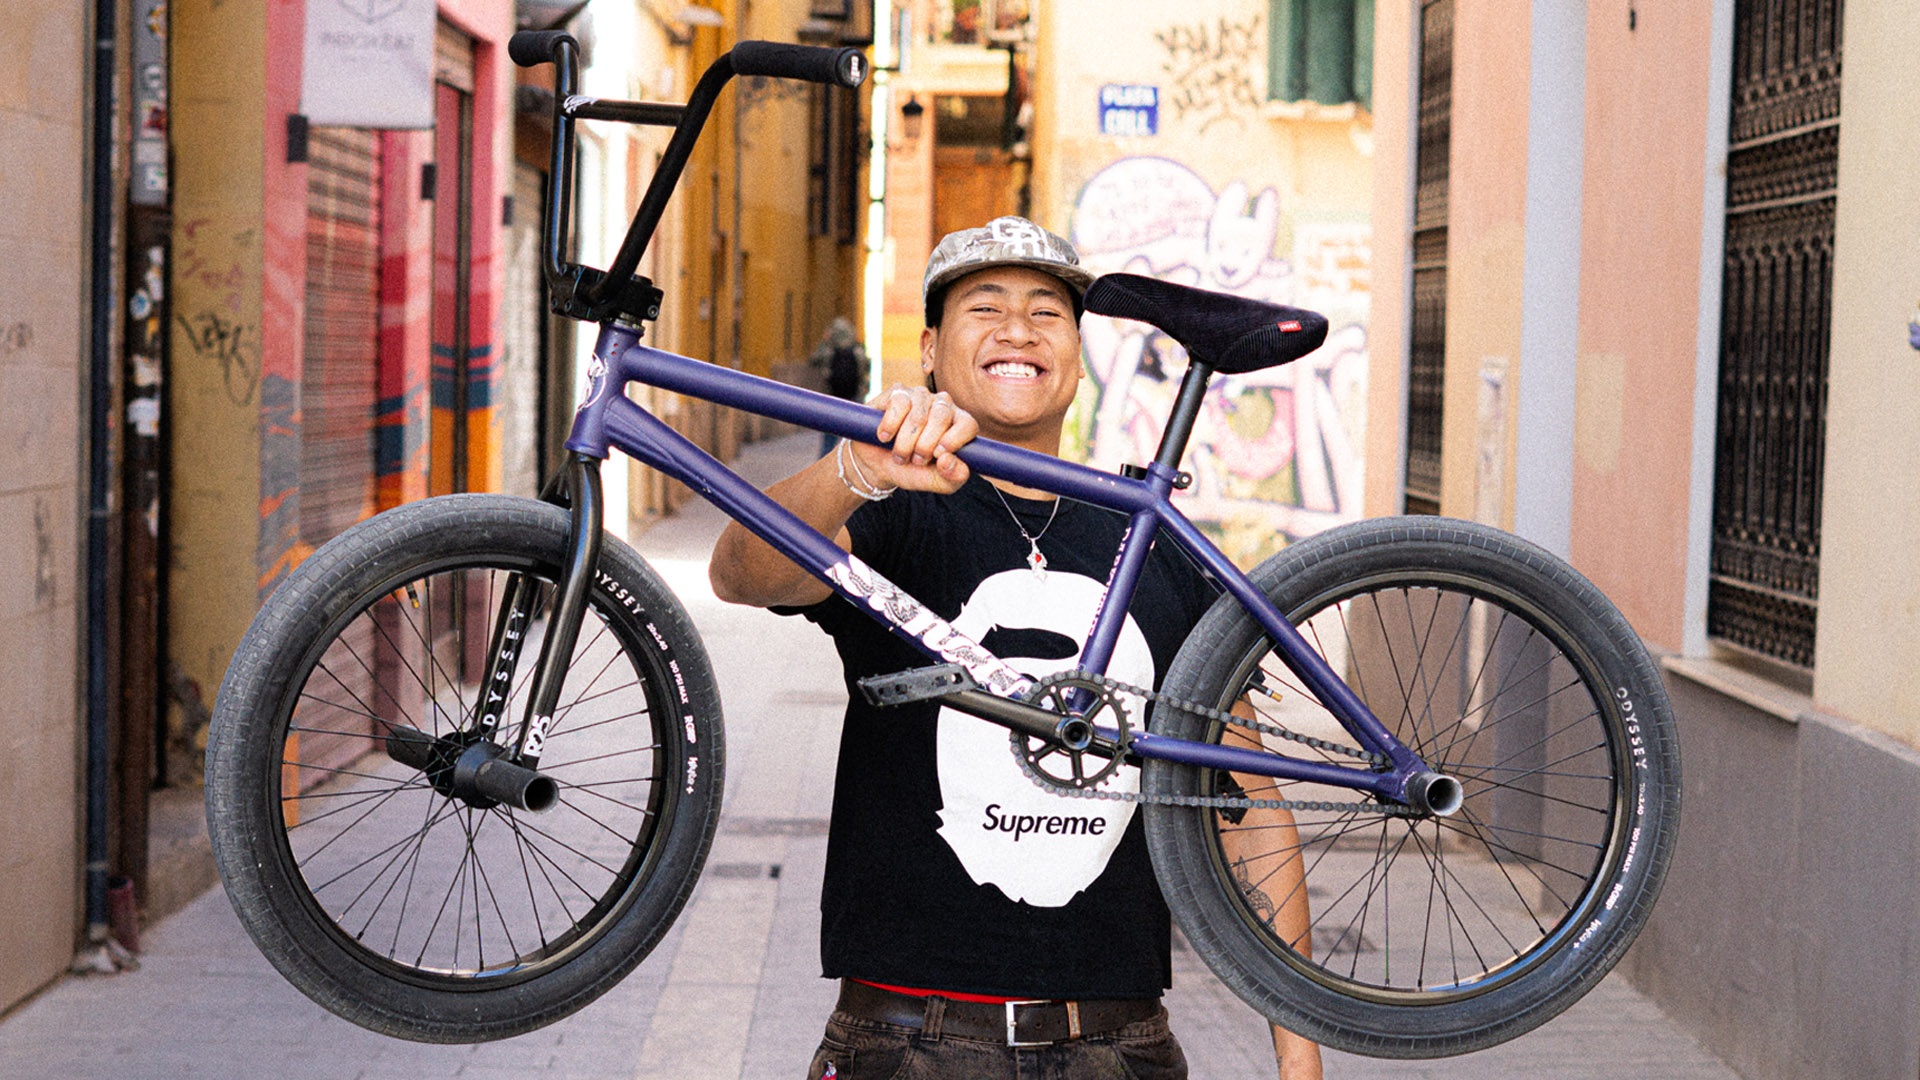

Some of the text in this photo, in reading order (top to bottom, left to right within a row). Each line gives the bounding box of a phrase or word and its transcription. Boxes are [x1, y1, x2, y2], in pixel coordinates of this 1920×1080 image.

[595, 569, 645, 614] YSSEY
[481, 607, 525, 743] DYSSEY
[669, 659, 689, 704] 100 PSI MAX
[1616, 686, 1648, 770] ODYSSEY
[982, 803, 1106, 842] Supreme
[1631, 827, 1641, 841] 100
[1622, 855, 1635, 873] MAX
